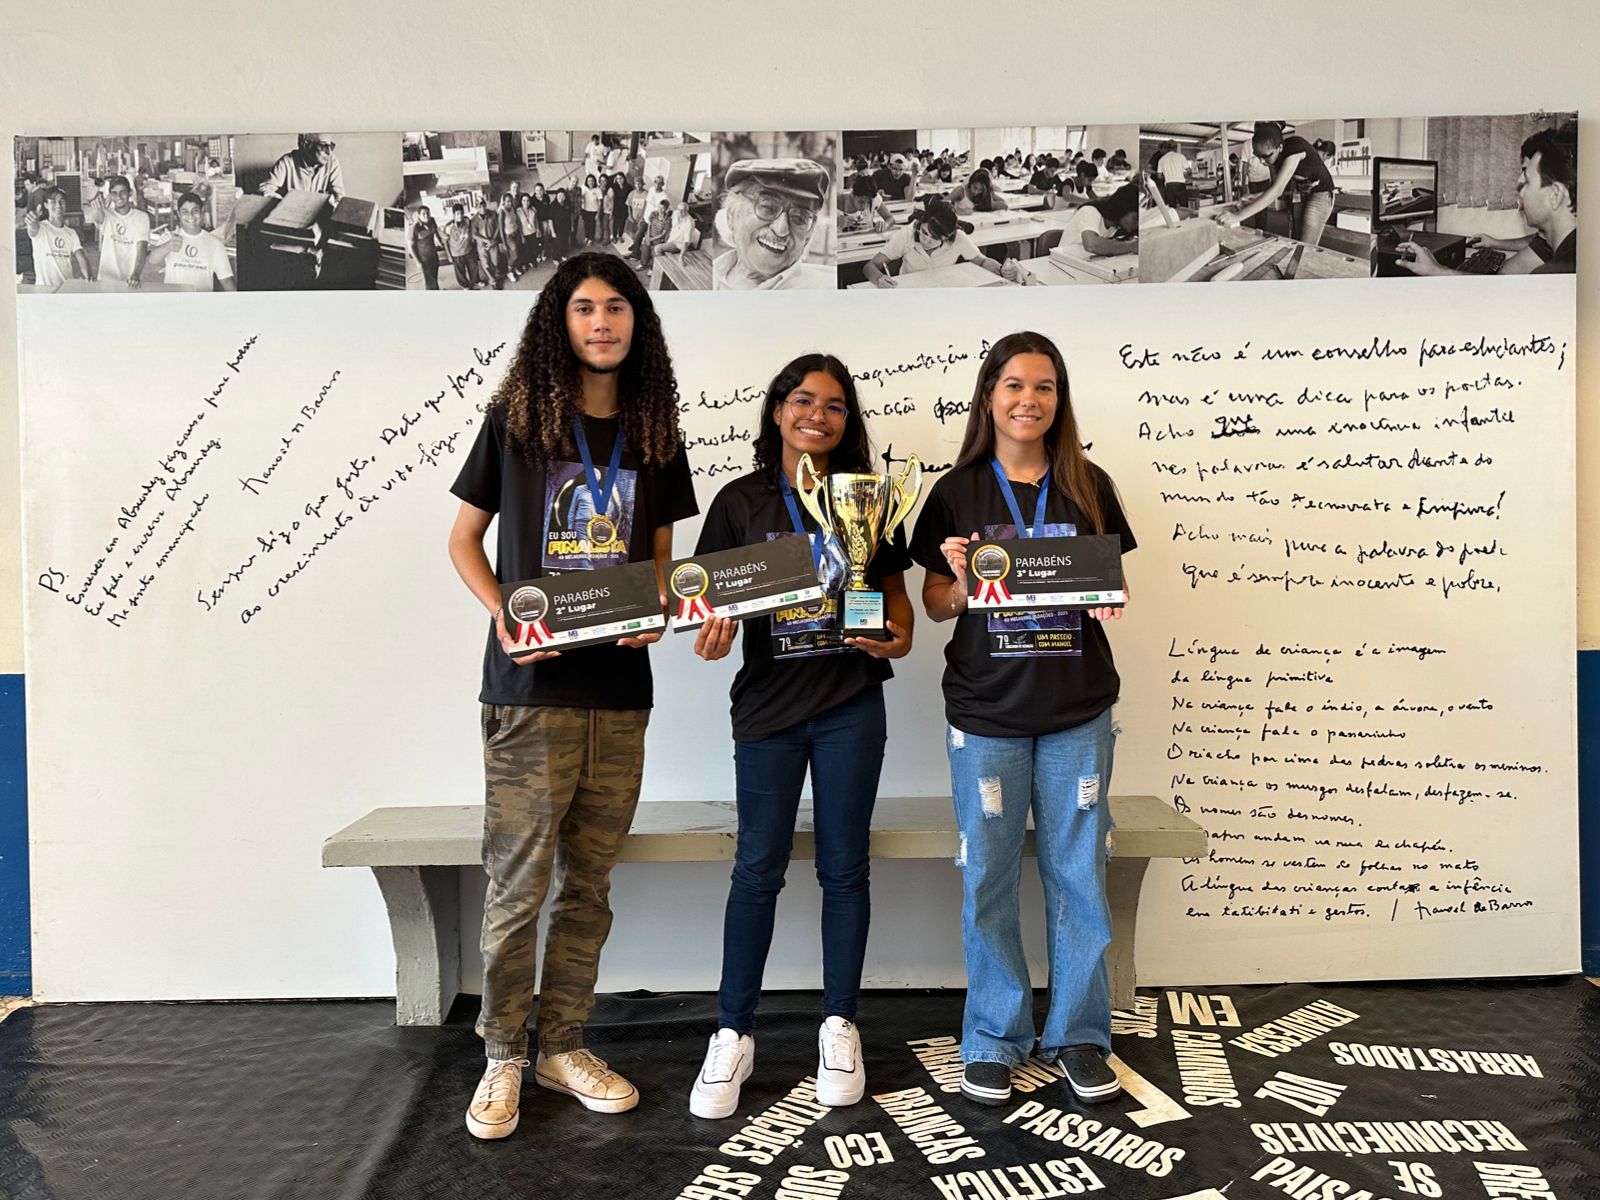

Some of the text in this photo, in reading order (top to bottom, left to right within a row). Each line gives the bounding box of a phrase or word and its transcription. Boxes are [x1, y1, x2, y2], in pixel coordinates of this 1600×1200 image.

[548, 531, 577, 540] EU SOU
[548, 540, 627, 555] FINALTA
[713, 561, 768, 581] PARABÉNS
[1015, 555, 1072, 568] PARABÉNS
[1028, 569, 1057, 579] Lugar
[553, 587, 611, 605] PARABÉNS
[725, 576, 753, 589] Lugar
[568, 603, 597, 614] Lugar
[1166, 991, 1241, 1027] EM
[1228, 999, 1361, 1058] ATRAVESSA
[1170, 1029, 1242, 1108] CAMINHOS
[1328, 1041, 1544, 1079] ARRASTADOS
[1253, 1070, 1348, 1118] VOZ
[718, 1075, 833, 1165] GITAÇÕES
[871, 1086, 987, 1166] BRANCAS
[1250, 1120, 1528, 1157] RECONHECÍVEIS
[823, 1130, 895, 1171] ECO
[1001, 1100, 1186, 1178] PASSAROS
[1387, 1159, 1443, 1198] SE
